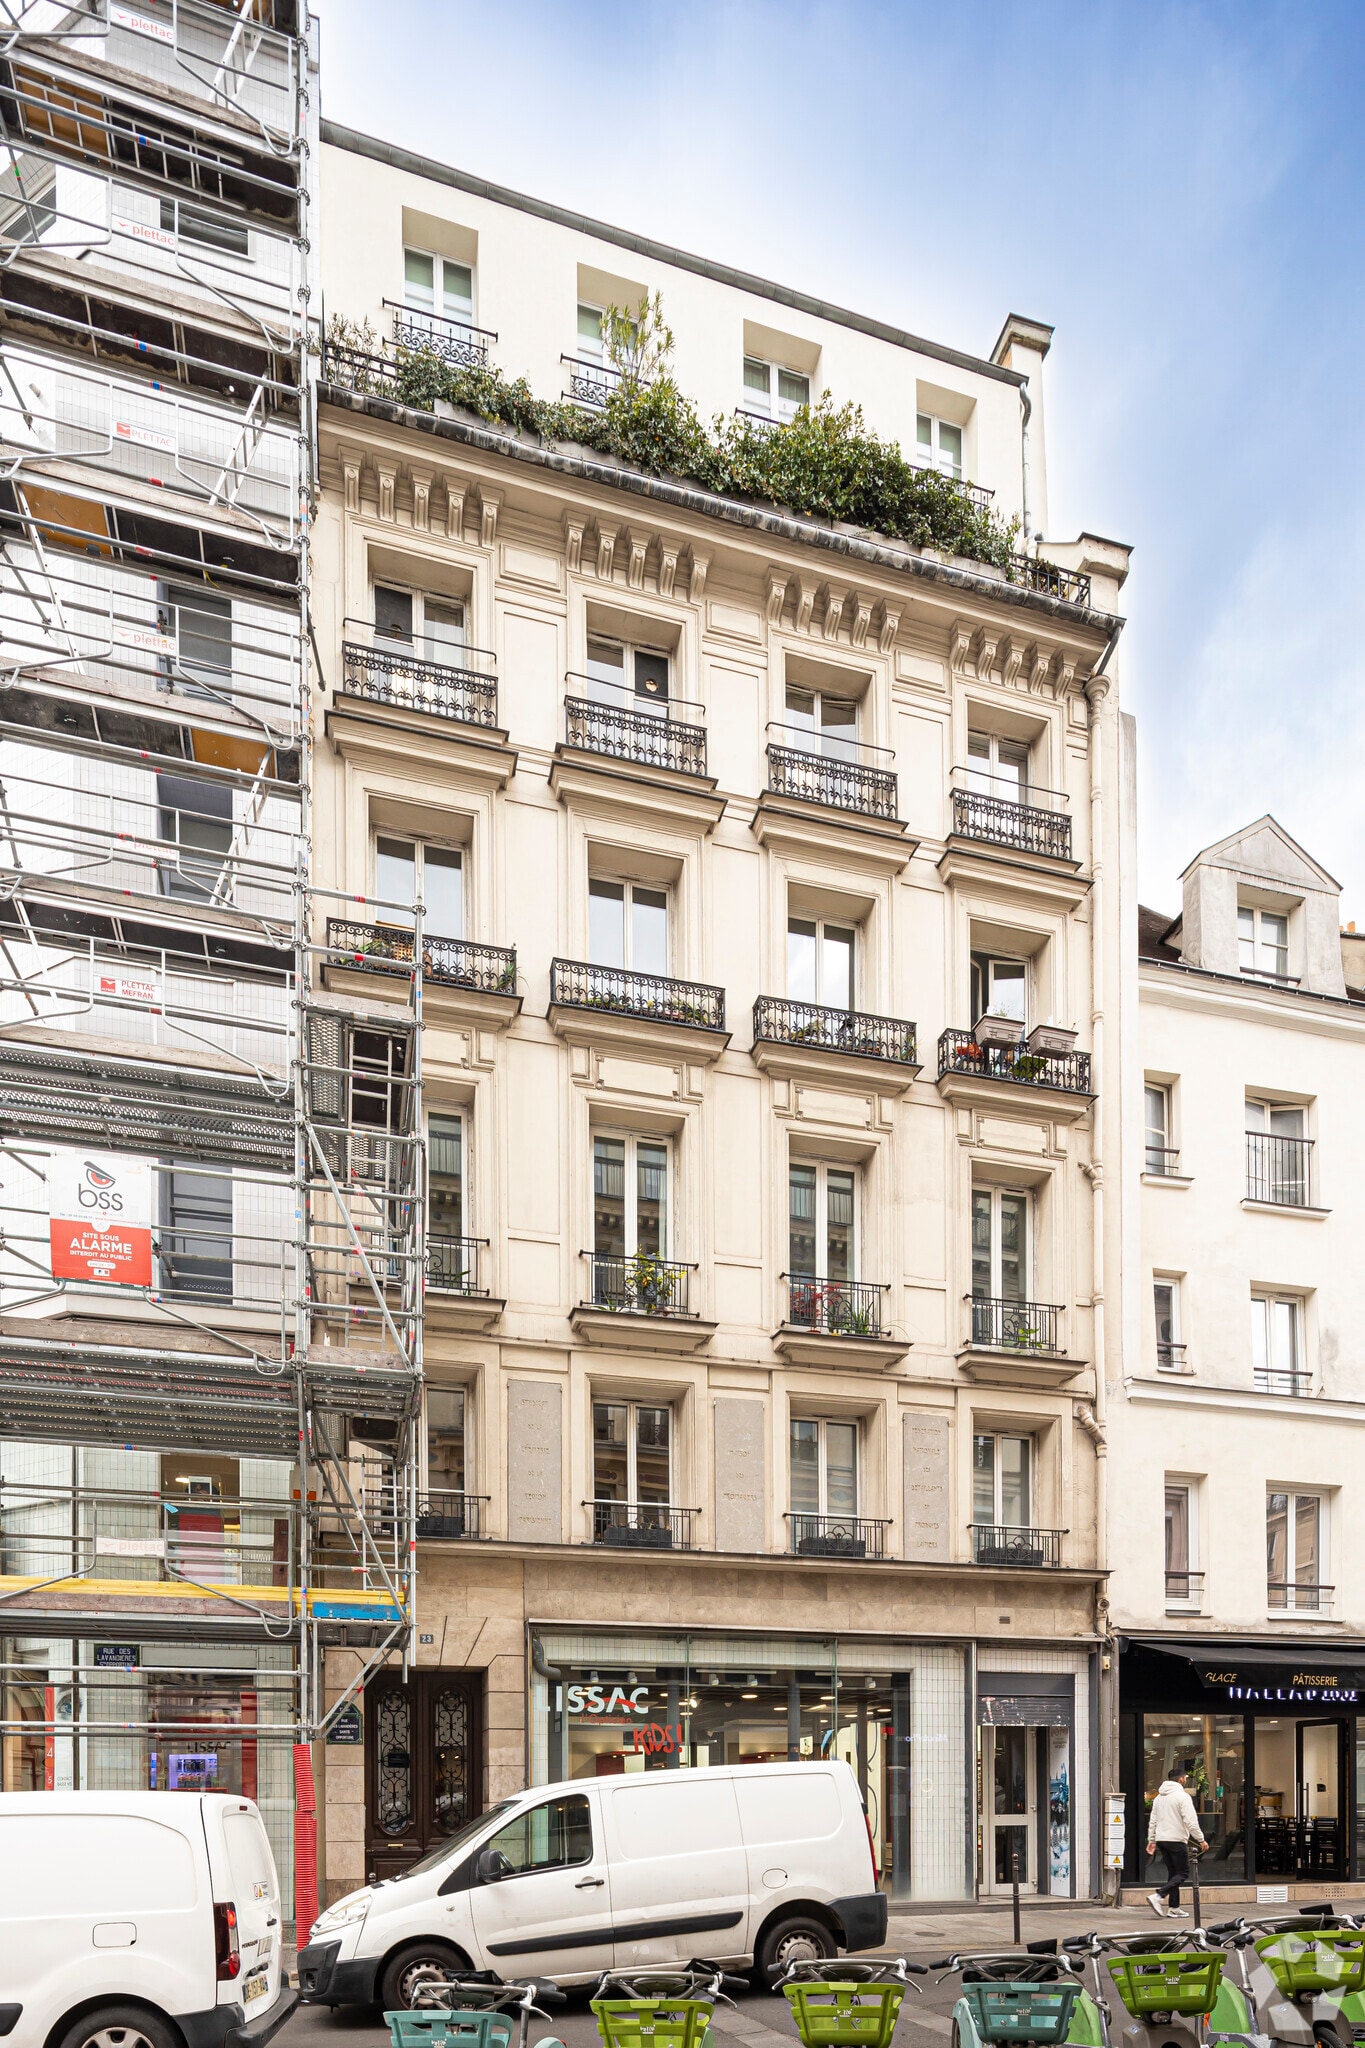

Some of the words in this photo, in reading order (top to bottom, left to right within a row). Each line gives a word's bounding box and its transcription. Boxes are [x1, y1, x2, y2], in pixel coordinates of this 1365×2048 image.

[131, 18, 173, 40] plettac
[132, 225, 174, 245] plettac
[132, 429, 172, 447] PLETTAC
[133, 633, 175, 650] plettac
[121, 980, 155, 992] PLETTAC
[121, 989, 153, 1000] MEFRAN
[78, 1183, 123, 1211] bss
[82, 1232, 98, 1240] SITE
[100, 1234, 119, 1242] SOUS
[70, 1237, 132, 1255] ALARME
[69, 1249, 98, 1258] INTERDIT
[118, 1541, 164, 1553] plettac
[422, 1635, 432, 1643] 23
[103, 1647, 115, 1655] RUE
[1205, 1672, 1238, 1683] GLACE
[1292, 1673, 1338, 1686] PÂTISSERIE
[535, 1685, 649, 1714] LISSAC
[581, 1713, 633, 1726] l'Opticien
